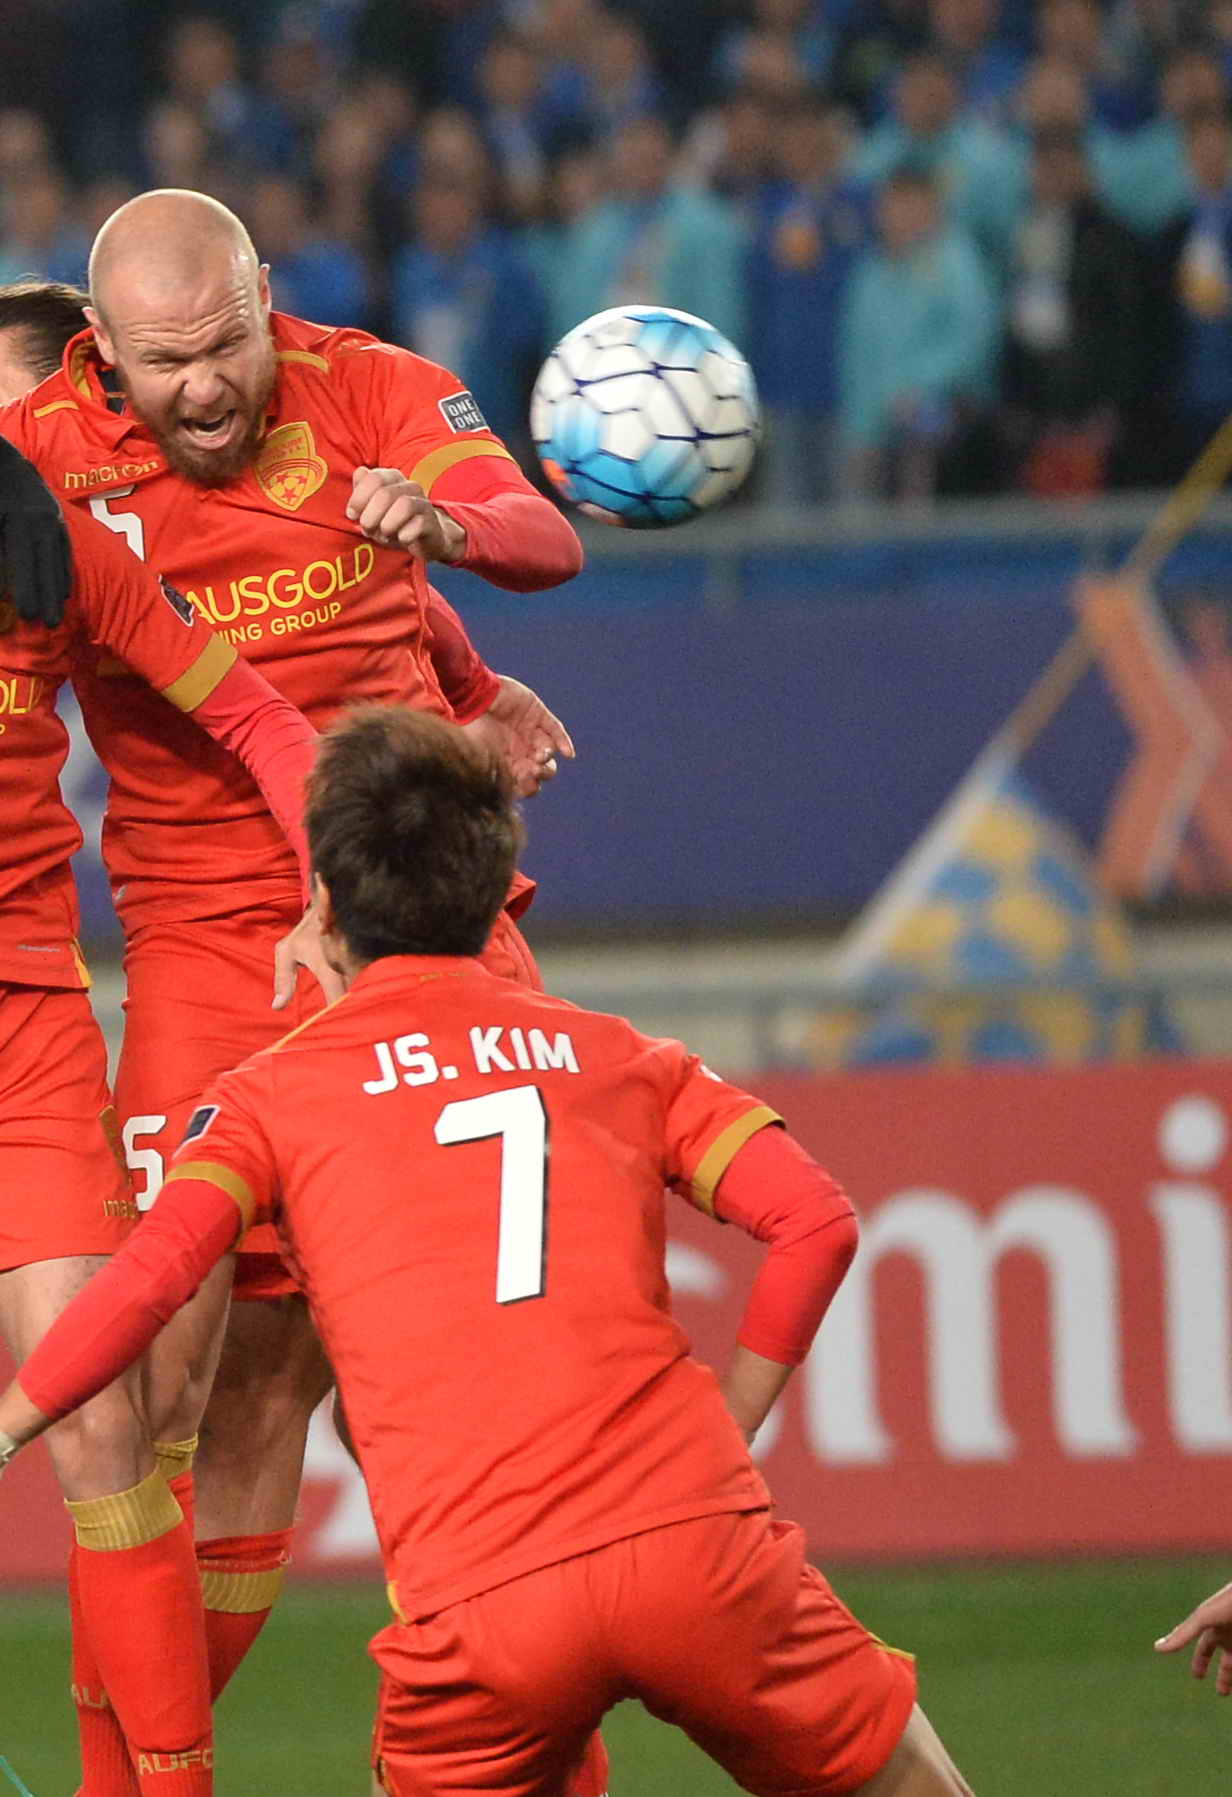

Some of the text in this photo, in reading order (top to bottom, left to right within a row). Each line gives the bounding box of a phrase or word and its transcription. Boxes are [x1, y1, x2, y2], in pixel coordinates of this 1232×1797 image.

[447, 398, 475, 418] ONE
[454, 411, 481, 429] ONE
[270, 602, 342, 636] GROUP
[362, 1026, 580, 1096] JS. KIM
[122, 1115, 167, 1213] 5
[433, 1084, 550, 1307] 7
[665, 1092, 1232, 1468] mi
